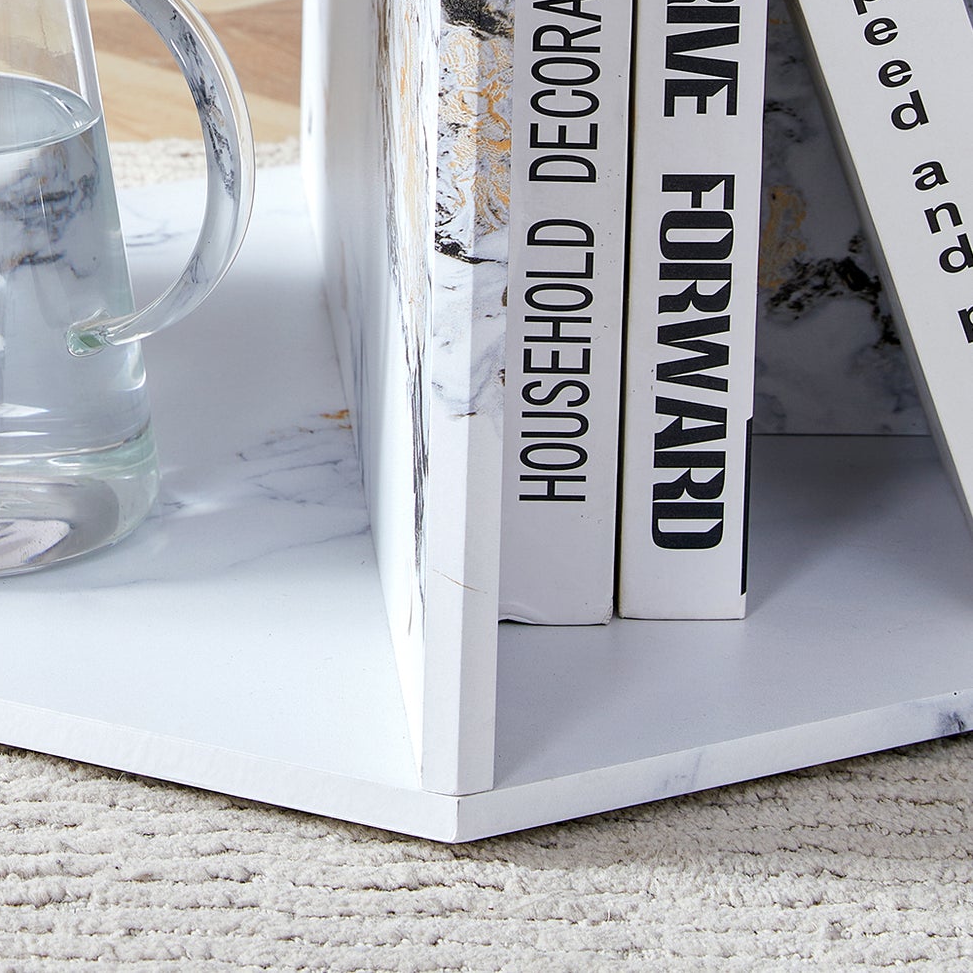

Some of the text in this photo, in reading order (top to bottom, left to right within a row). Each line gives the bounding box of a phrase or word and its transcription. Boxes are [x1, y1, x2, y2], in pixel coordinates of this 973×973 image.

[518, 218, 595, 502] HOUSEHOLD
[911, 161, 973, 275] and
[651, 173, 736, 550] FORWARD
